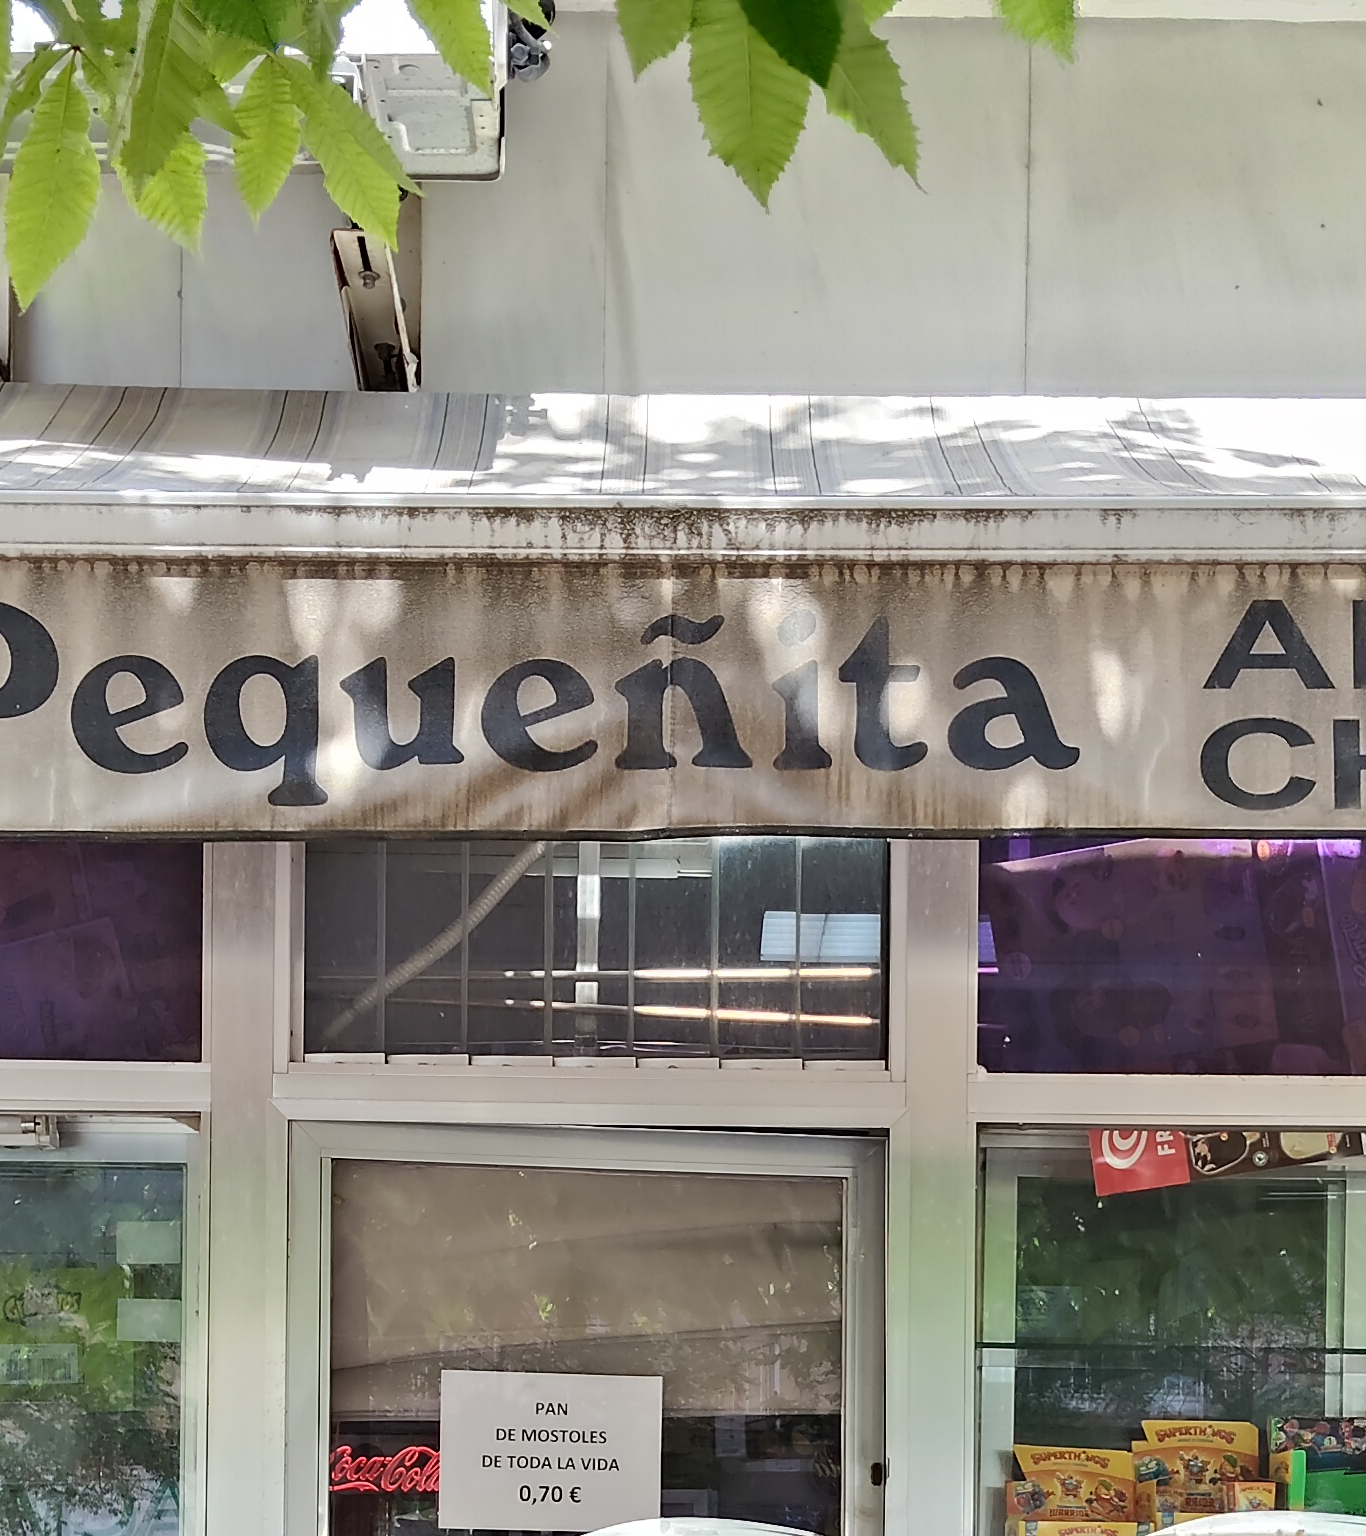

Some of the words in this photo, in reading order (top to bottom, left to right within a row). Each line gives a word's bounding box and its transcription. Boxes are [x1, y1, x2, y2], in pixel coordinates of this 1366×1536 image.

[535, 1402, 568, 1416] PAN
[495, 1428, 518, 1442] DE
[521, 1429, 607, 1444] MOSTOLES
[482, 1456, 505, 1469] DE
[508, 1456, 553, 1470] TODA
[557, 1457, 577, 1471] LA
[581, 1457, 620, 1472] VIDA
[519, 1484, 564, 1507] 0,70
[569, 1486, 582, 1504] €
